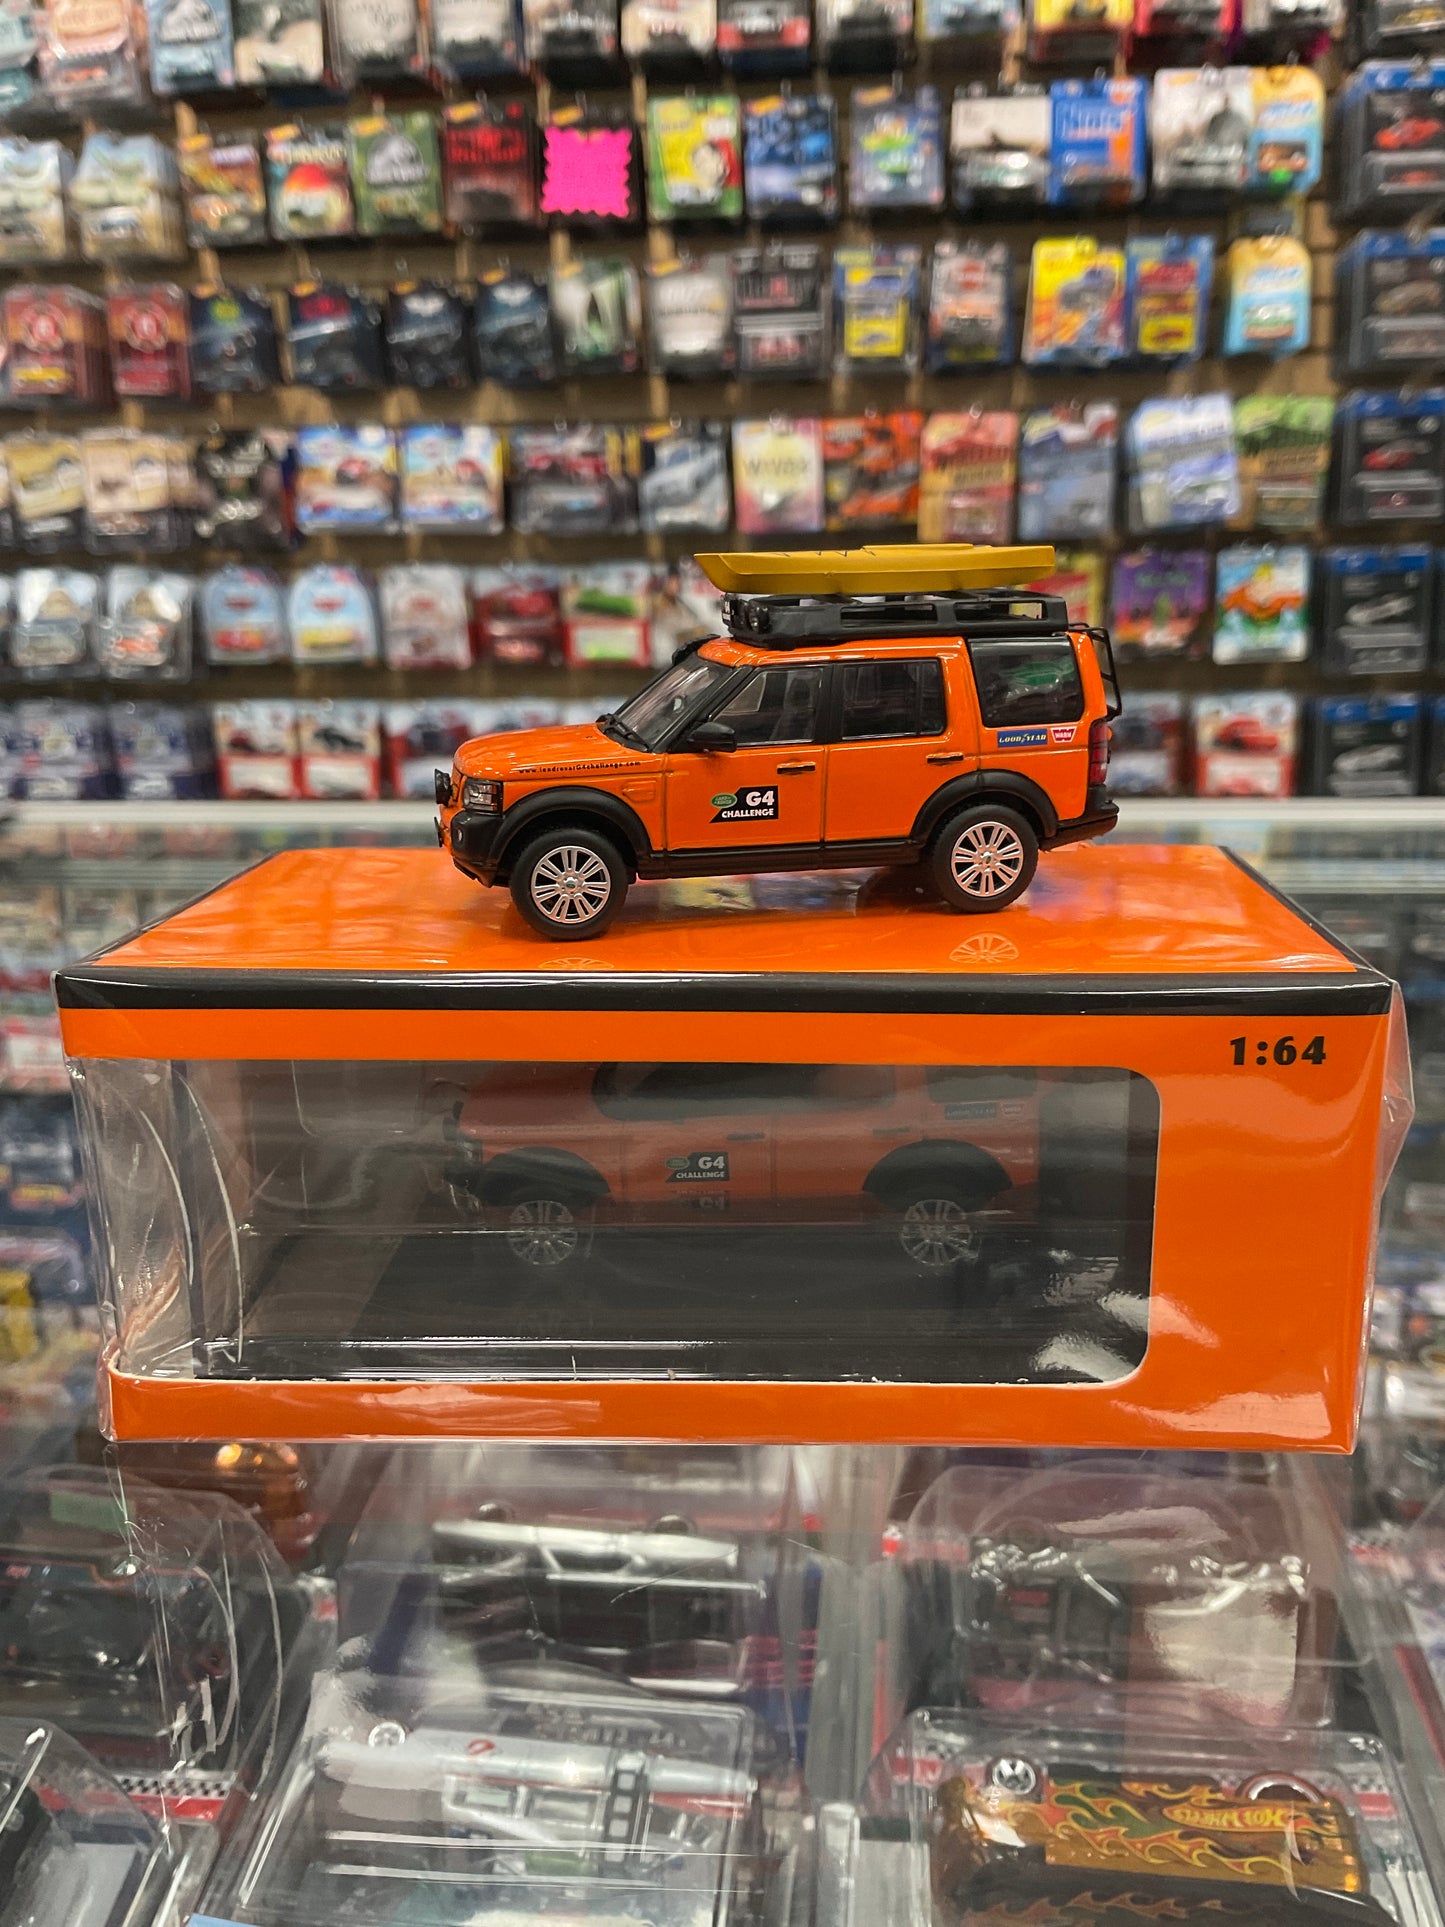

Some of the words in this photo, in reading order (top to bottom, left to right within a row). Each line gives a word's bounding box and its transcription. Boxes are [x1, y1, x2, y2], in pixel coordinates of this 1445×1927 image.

[746, 790, 775, 807] G4
[721, 808, 774, 818] CHALLENGE
[1230, 1035, 1327, 1065] 1:64
[698, 1156, 725, 1170] G4
[675, 1171, 725, 1179] CHALLENGE
